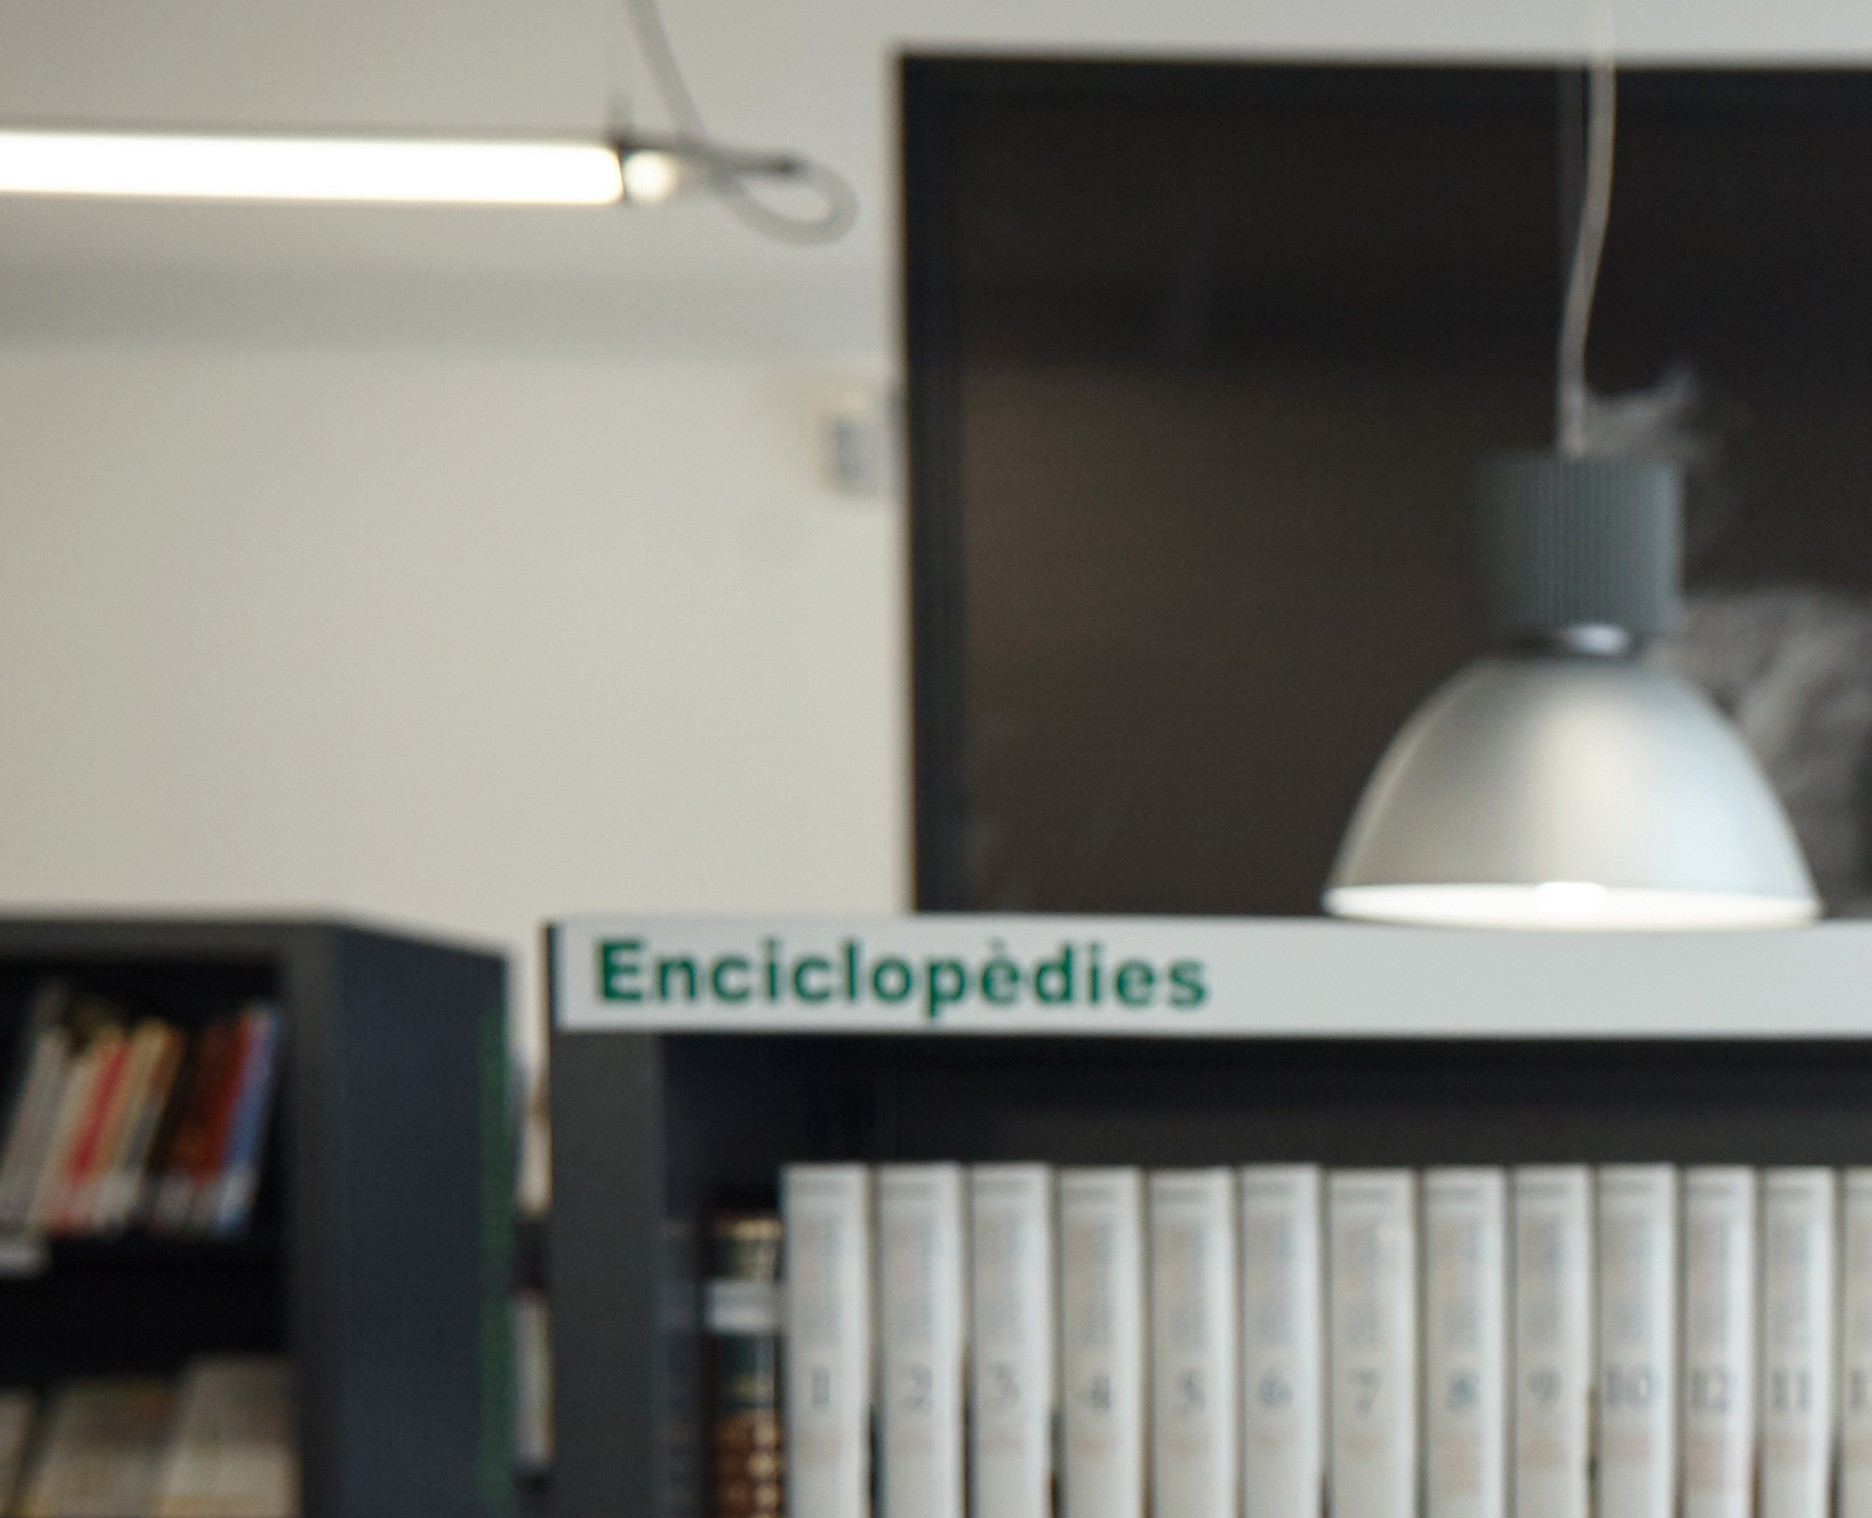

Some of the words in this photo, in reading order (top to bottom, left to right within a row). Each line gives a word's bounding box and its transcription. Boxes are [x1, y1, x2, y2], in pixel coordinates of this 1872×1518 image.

[597, 937, 1210, 1023] Enciclopèdies
[810, 1367, 832, 1409] 1
[899, 1365, 935, 1411] 2
[984, 1361, 1020, 1408] 3
[1257, 1365, 1293, 1409] 6
[1349, 1367, 1383, 1415] 7
[1528, 1365, 1562, 1410] 9
[1605, 1365, 1658, 1410] 10
[1771, 1366, 1812, 1411] 11
